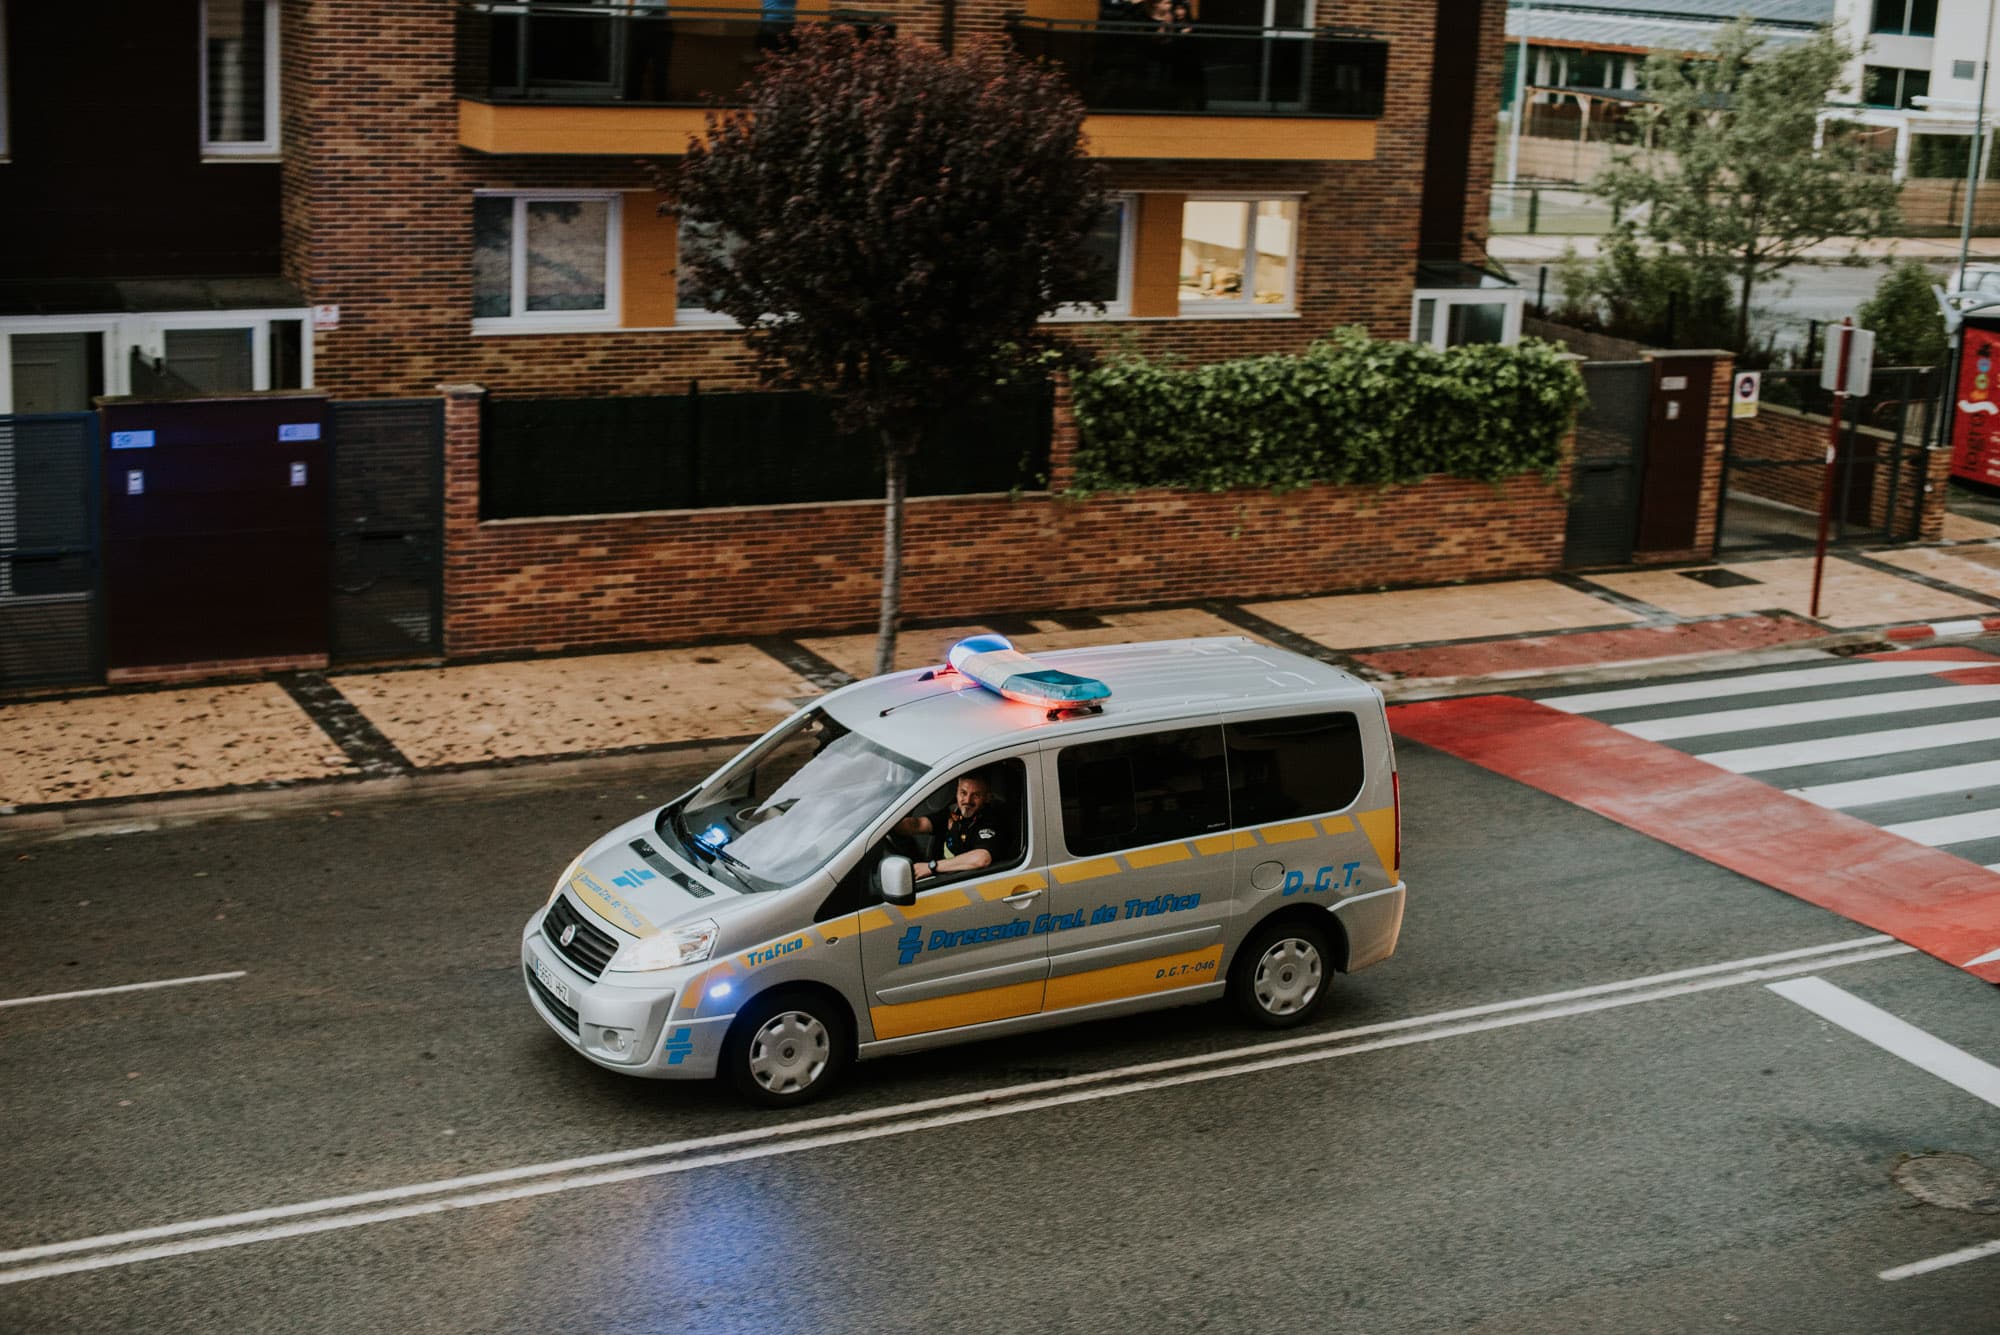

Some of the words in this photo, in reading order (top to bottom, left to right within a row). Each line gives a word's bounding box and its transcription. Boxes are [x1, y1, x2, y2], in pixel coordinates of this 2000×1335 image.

[1282, 862, 1361, 896] D.G.T.
[928, 918, 1030, 951] Dirección
[1090, 904, 1118, 925] de
[1124, 893, 1201, 919] Tráfico
